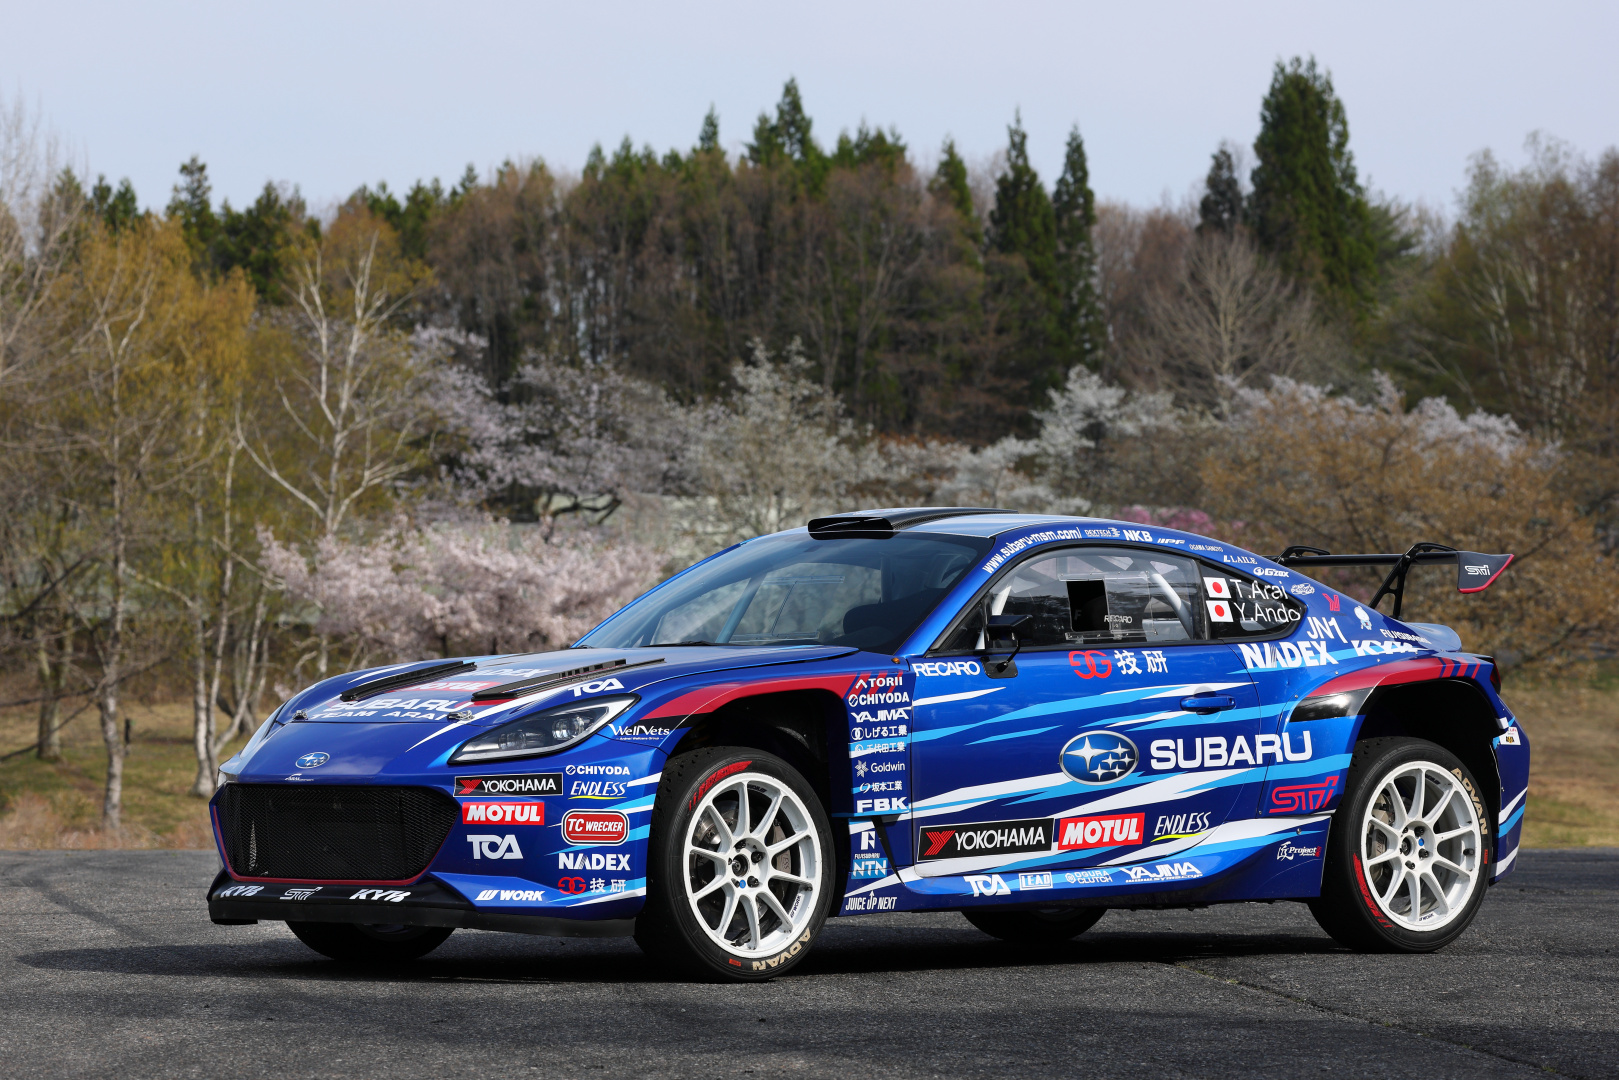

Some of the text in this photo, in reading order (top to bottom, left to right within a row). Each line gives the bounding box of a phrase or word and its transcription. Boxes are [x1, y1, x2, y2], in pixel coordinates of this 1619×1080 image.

[1122, 529, 1153, 542] NKB
[1229, 578, 1289, 600] T.Arai
[1233, 602, 1301, 623] Y.Ando
[1306, 616, 1348, 644] JN1
[1114, 649, 1168, 675] 技研
[1237, 640, 1340, 670] NADEX
[912, 660, 981, 677] RECARO
[568, 677, 625, 698] TOA
[868, 676, 903, 688] TORII
[322, 699, 474, 712] SUBARU
[859, 691, 910, 706] CHIYODA
[310, 710, 448, 721] TEAM ARAI
[850, 707, 910, 723] YAJIMA
[608, 722, 670, 737] WellVets
[865, 724, 908, 739] しげる工業
[1150, 730, 1313, 770] SUBARU
[576, 765, 631, 776] CHIYODA
[870, 760, 906, 773] Goldwin
[482, 778, 557, 793] YOKOHAMA
[570, 780, 627, 797] ENDLESS
[856, 796, 908, 814] FBK
[1449, 767, 1489, 836] ADVAN
[466, 804, 542, 823] MOTUL
[567, 818, 624, 832] TC WRECKER
[1061, 817, 1140, 846] MOTUL
[1153, 811, 1212, 836] ENDLESS
[466, 834, 524, 860] TOA
[954, 826, 1046, 851] YOKOHAMA
[558, 852, 631, 871] NADEX
[852, 859, 887, 878] NTN
[1119, 861, 1203, 880] YAJIMA
[590, 877, 627, 894] 技研
[963, 874, 1011, 898] TOA
[1021, 873, 1051, 889] LEAD
[349, 888, 412, 902] KYB
[500, 889, 546, 901] WORK
[845, 896, 866, 911] JUICE
[877, 896, 898, 910] NEXT
[752, 926, 812, 971] ADVAN
